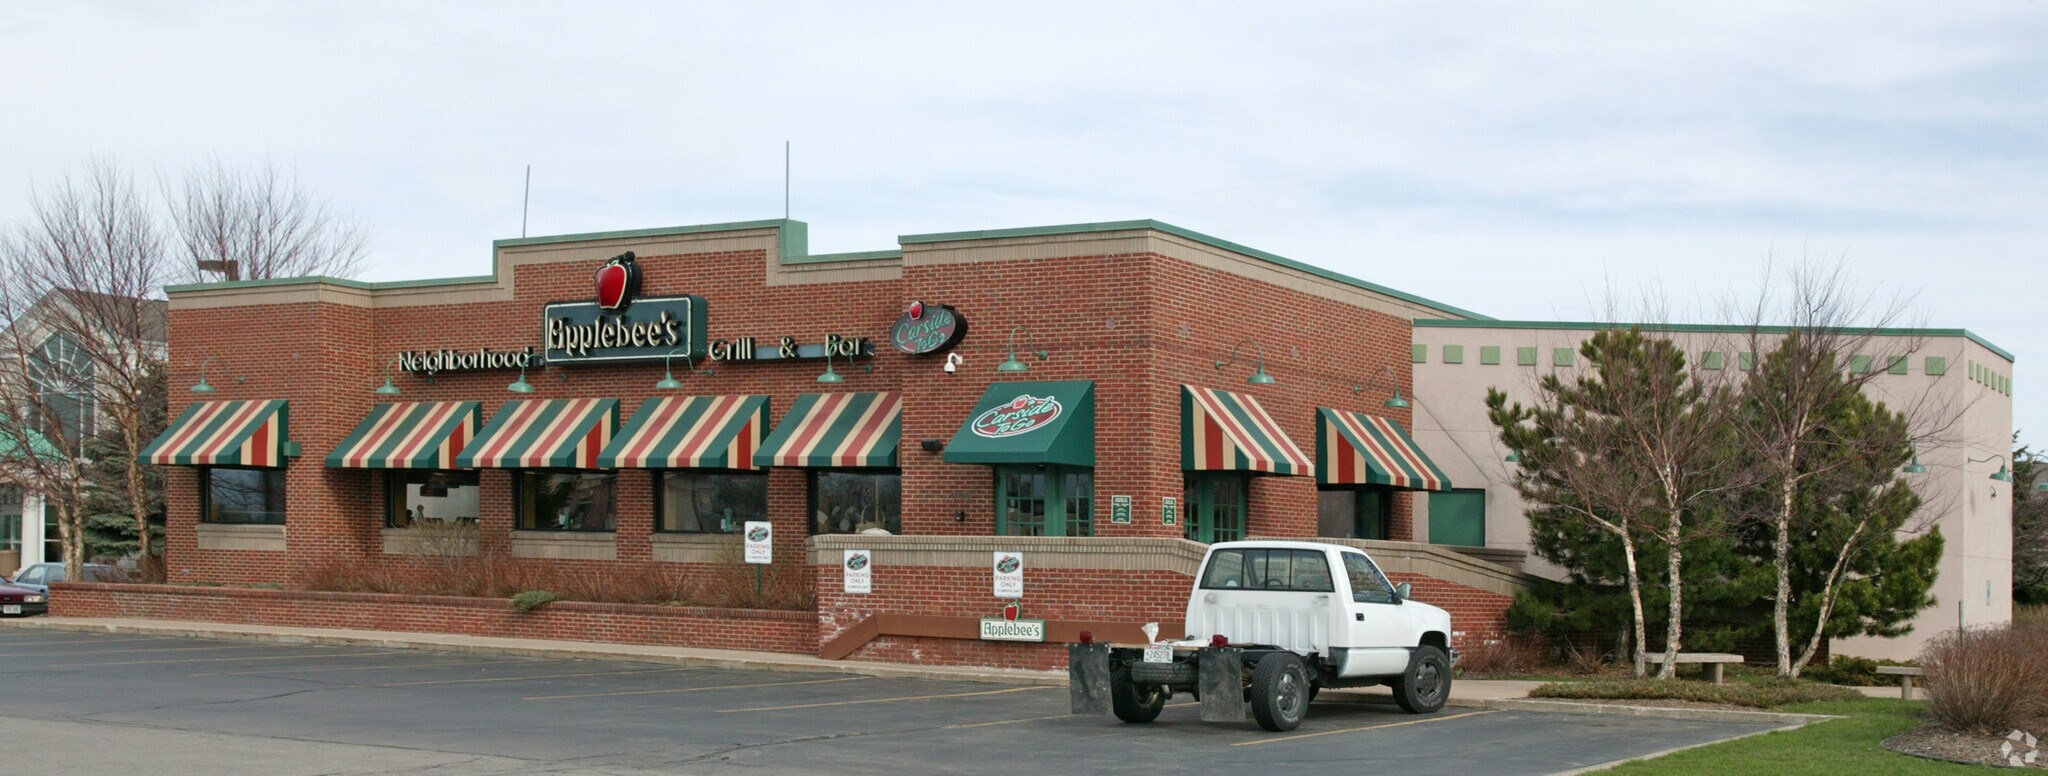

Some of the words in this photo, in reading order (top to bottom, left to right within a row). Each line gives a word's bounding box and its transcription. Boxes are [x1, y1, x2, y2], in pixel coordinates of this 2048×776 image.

[548, 310, 678, 356] Applebee's
[897, 309, 952, 344] Carside
[399, 346, 530, 375] Neighborhood
[708, 337, 752, 361] Grill
[779, 336, 797, 359] &
[825, 334, 861, 357] Bar
[976, 399, 1055, 427] Carside
[994, 422, 1011, 436] To
[1010, 417, 1036, 431] Go
[983, 621, 1040, 637] Applebee's
